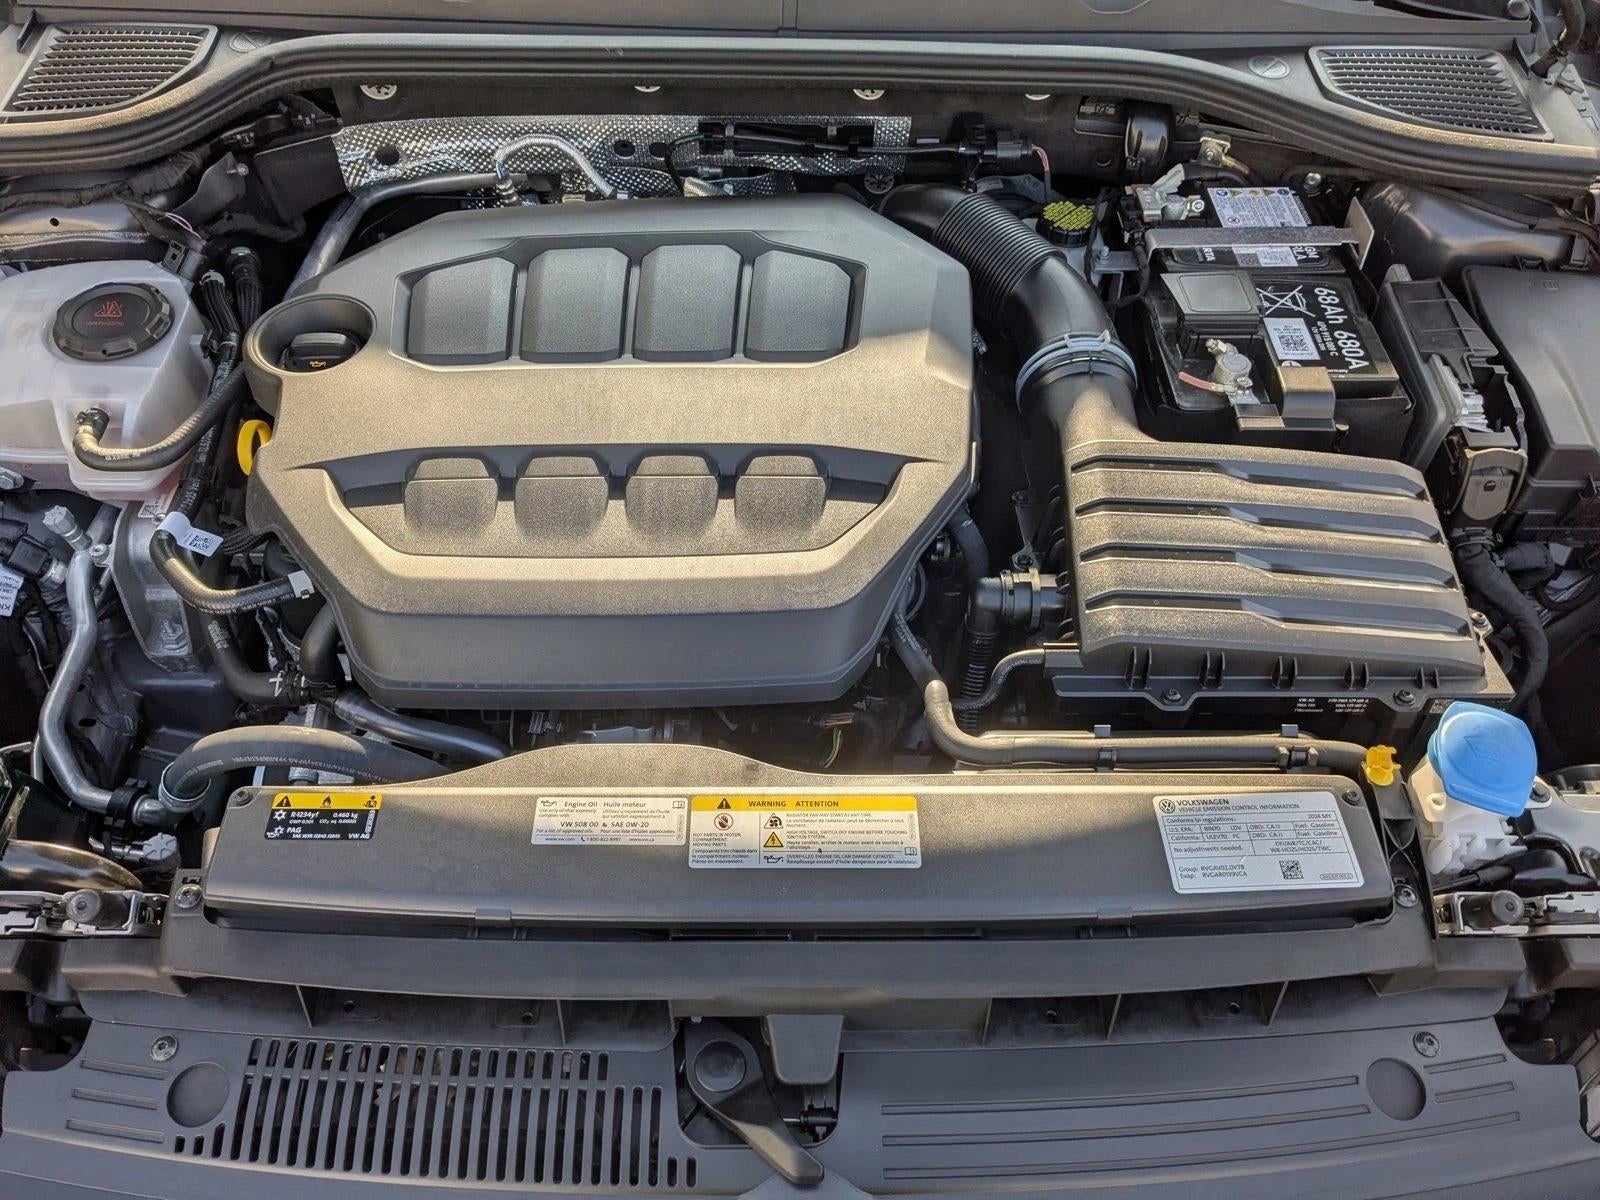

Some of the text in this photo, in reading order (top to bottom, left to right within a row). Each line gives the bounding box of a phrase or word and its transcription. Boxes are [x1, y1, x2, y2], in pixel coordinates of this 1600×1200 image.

[1203, 247, 1215, 261] RTA
[1292, 246, 1306, 260] RLA
[1304, 246, 1320, 258] GM
[1314, 287, 1348, 324] 68Ah
[1334, 330, 1370, 370] 680A
